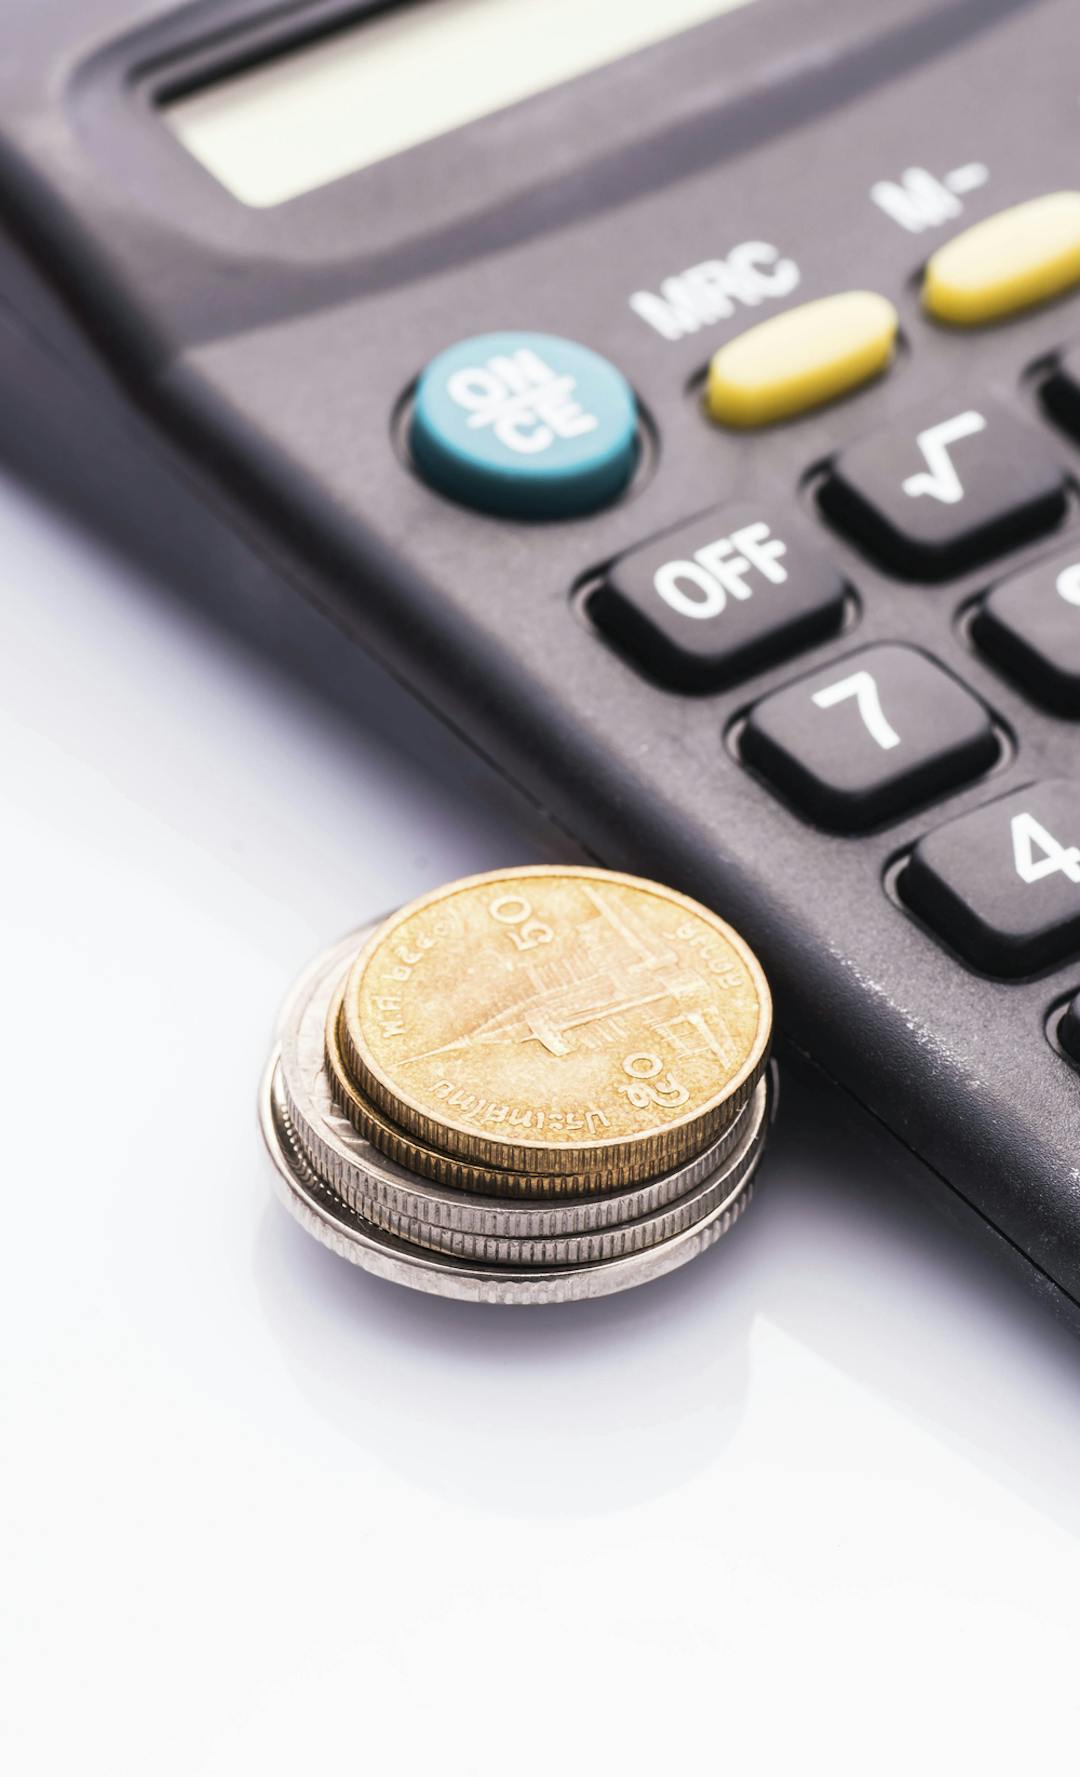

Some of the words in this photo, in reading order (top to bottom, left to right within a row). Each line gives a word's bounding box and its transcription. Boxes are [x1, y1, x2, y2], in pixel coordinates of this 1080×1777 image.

[630, 240, 801, 341] MRC
[447, 348, 556, 410] ON
[494, 402, 599, 454] CE
[653, 521, 789, 620] OFF
[811, 671, 900, 751] 7
[489, 895, 555, 951] 50
[431, 1078, 612, 1134] ประเทศไทย
